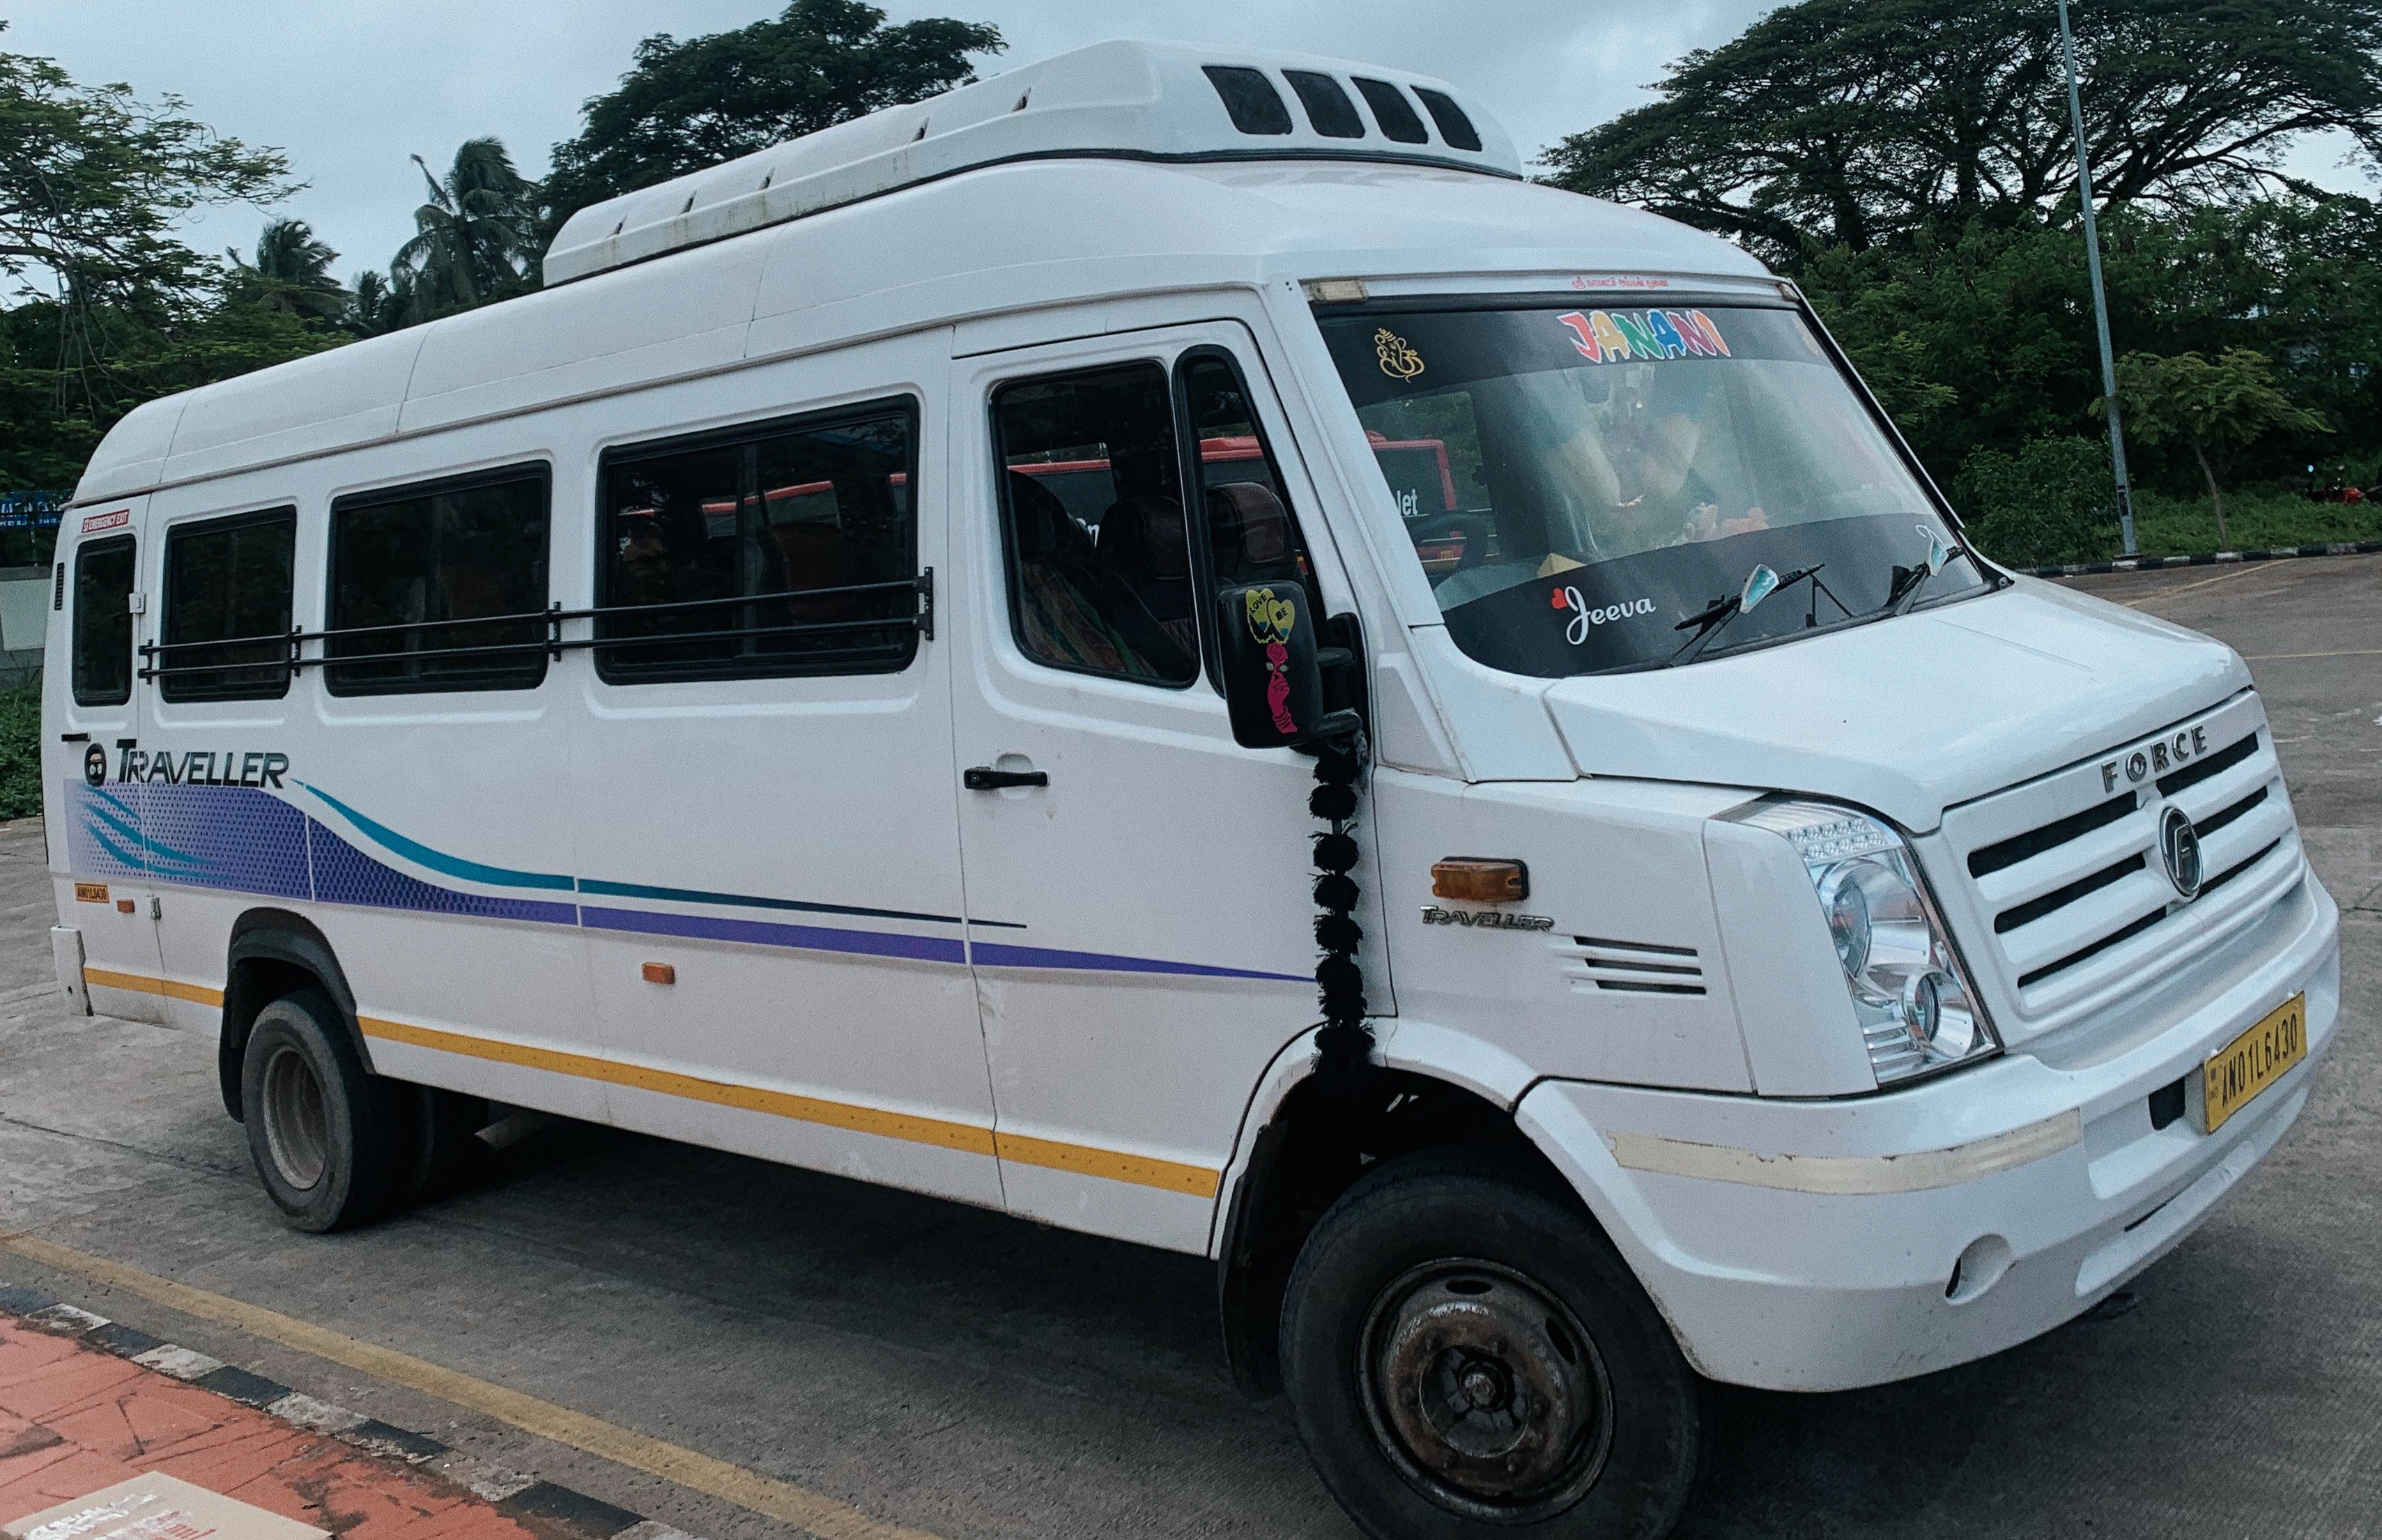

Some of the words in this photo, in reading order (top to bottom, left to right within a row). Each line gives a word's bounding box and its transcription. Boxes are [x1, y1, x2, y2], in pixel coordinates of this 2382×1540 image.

[1556, 309, 1731, 364] JANANI
[1249, 593, 1267, 613] LOVE
[1565, 586, 1657, 645] Jeeva
[116, 739, 289, 789] TRAVELLER
[2101, 725, 2207, 794] FORCE
[1420, 905, 1555, 932] TRAVELLER
